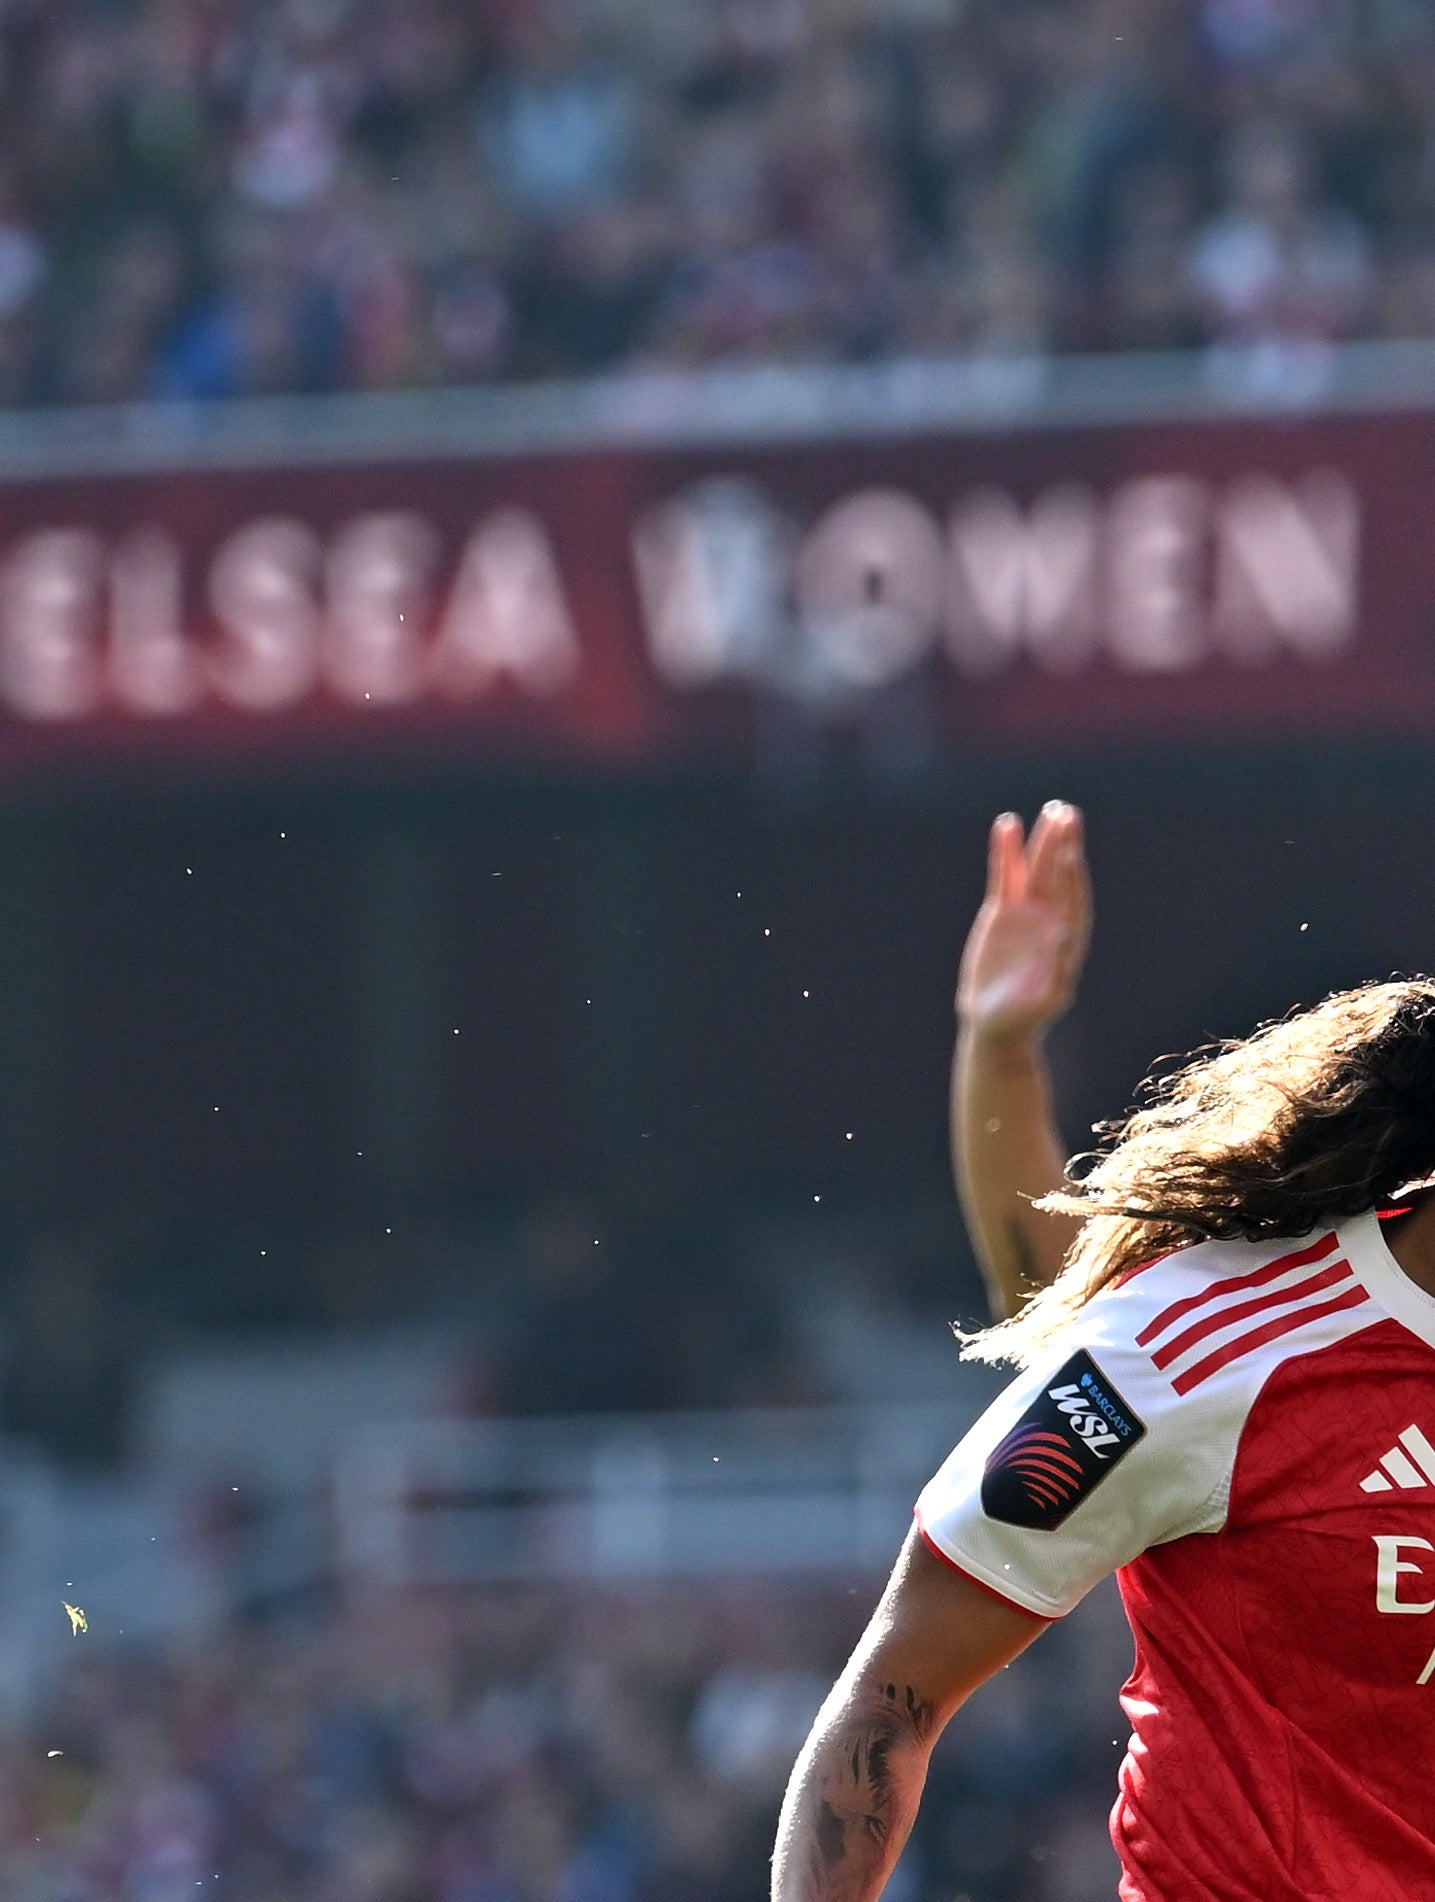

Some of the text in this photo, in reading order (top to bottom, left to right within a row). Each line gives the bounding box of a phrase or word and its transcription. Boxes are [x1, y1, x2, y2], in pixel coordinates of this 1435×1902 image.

[0, 468, 1361, 720] ELSEA WOMEN
[1048, 1383, 1121, 1460] WSL
[1087, 1384, 1132, 1437] BARCLAYS
